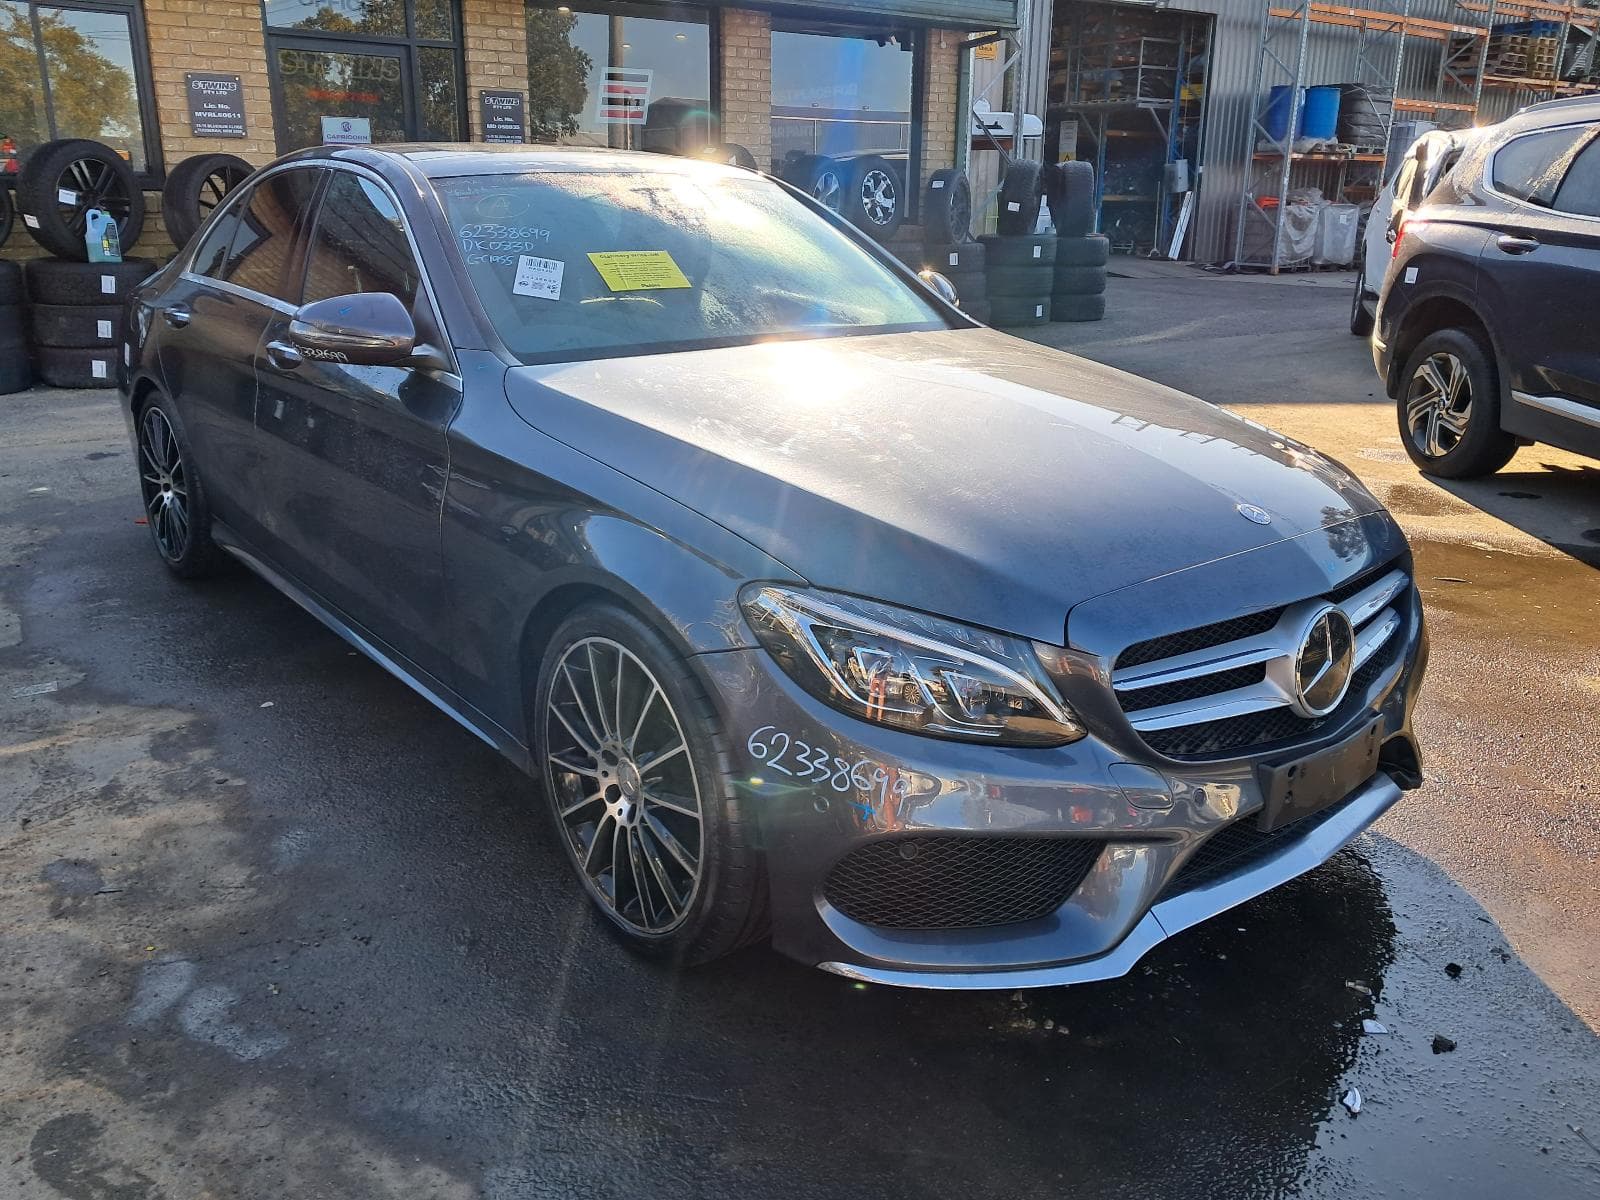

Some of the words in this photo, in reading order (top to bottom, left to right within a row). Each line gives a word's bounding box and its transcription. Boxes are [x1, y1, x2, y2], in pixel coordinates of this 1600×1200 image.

[326, 133, 368, 141] CAPRICORN
[459, 224, 550, 242] 62338699
[748, 725, 909, 817] 62338699
